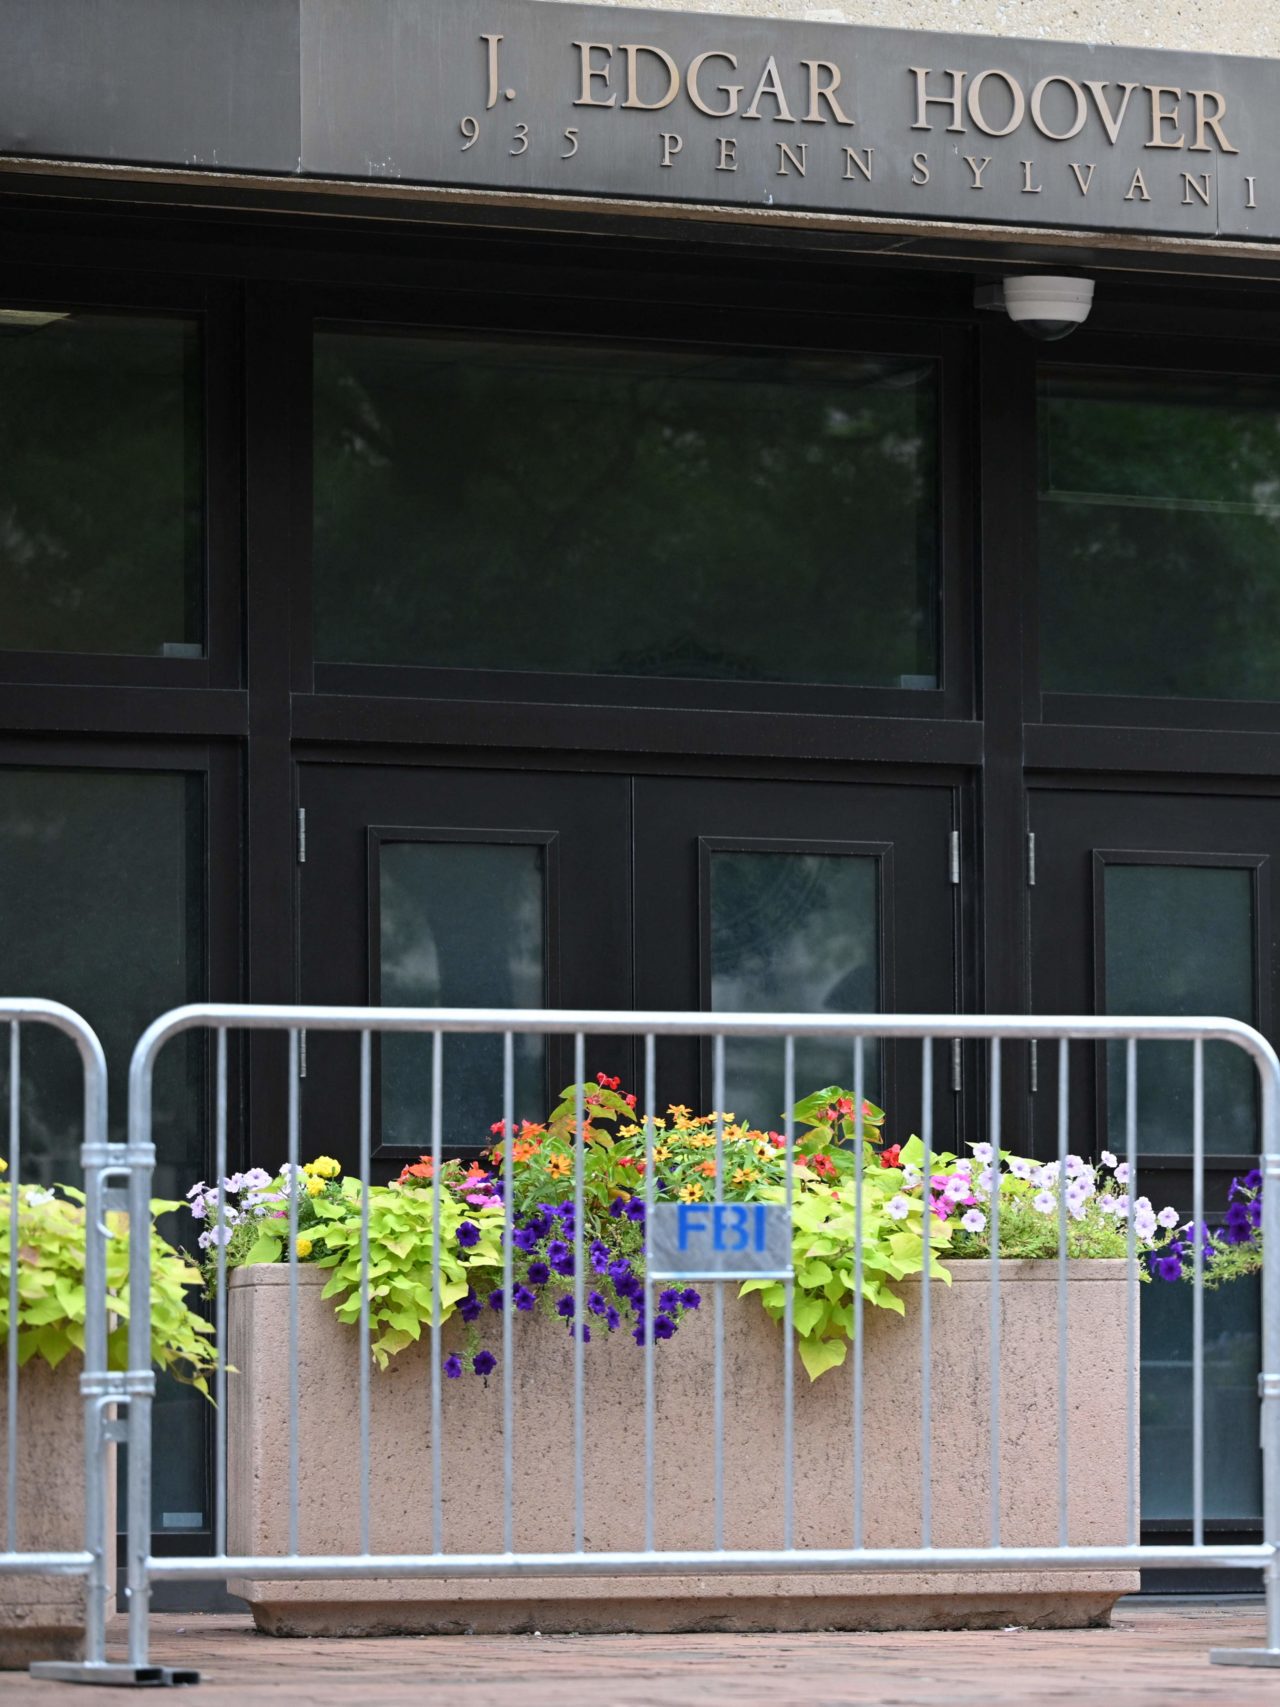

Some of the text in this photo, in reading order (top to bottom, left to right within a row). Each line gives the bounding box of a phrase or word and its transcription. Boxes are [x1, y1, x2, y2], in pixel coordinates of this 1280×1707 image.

[480, 34, 517, 110] J.
[572, 41, 856, 125] EDGAR
[908, 66, 1240, 154] HOOVER
[677, 1204, 766, 1252] FBI
